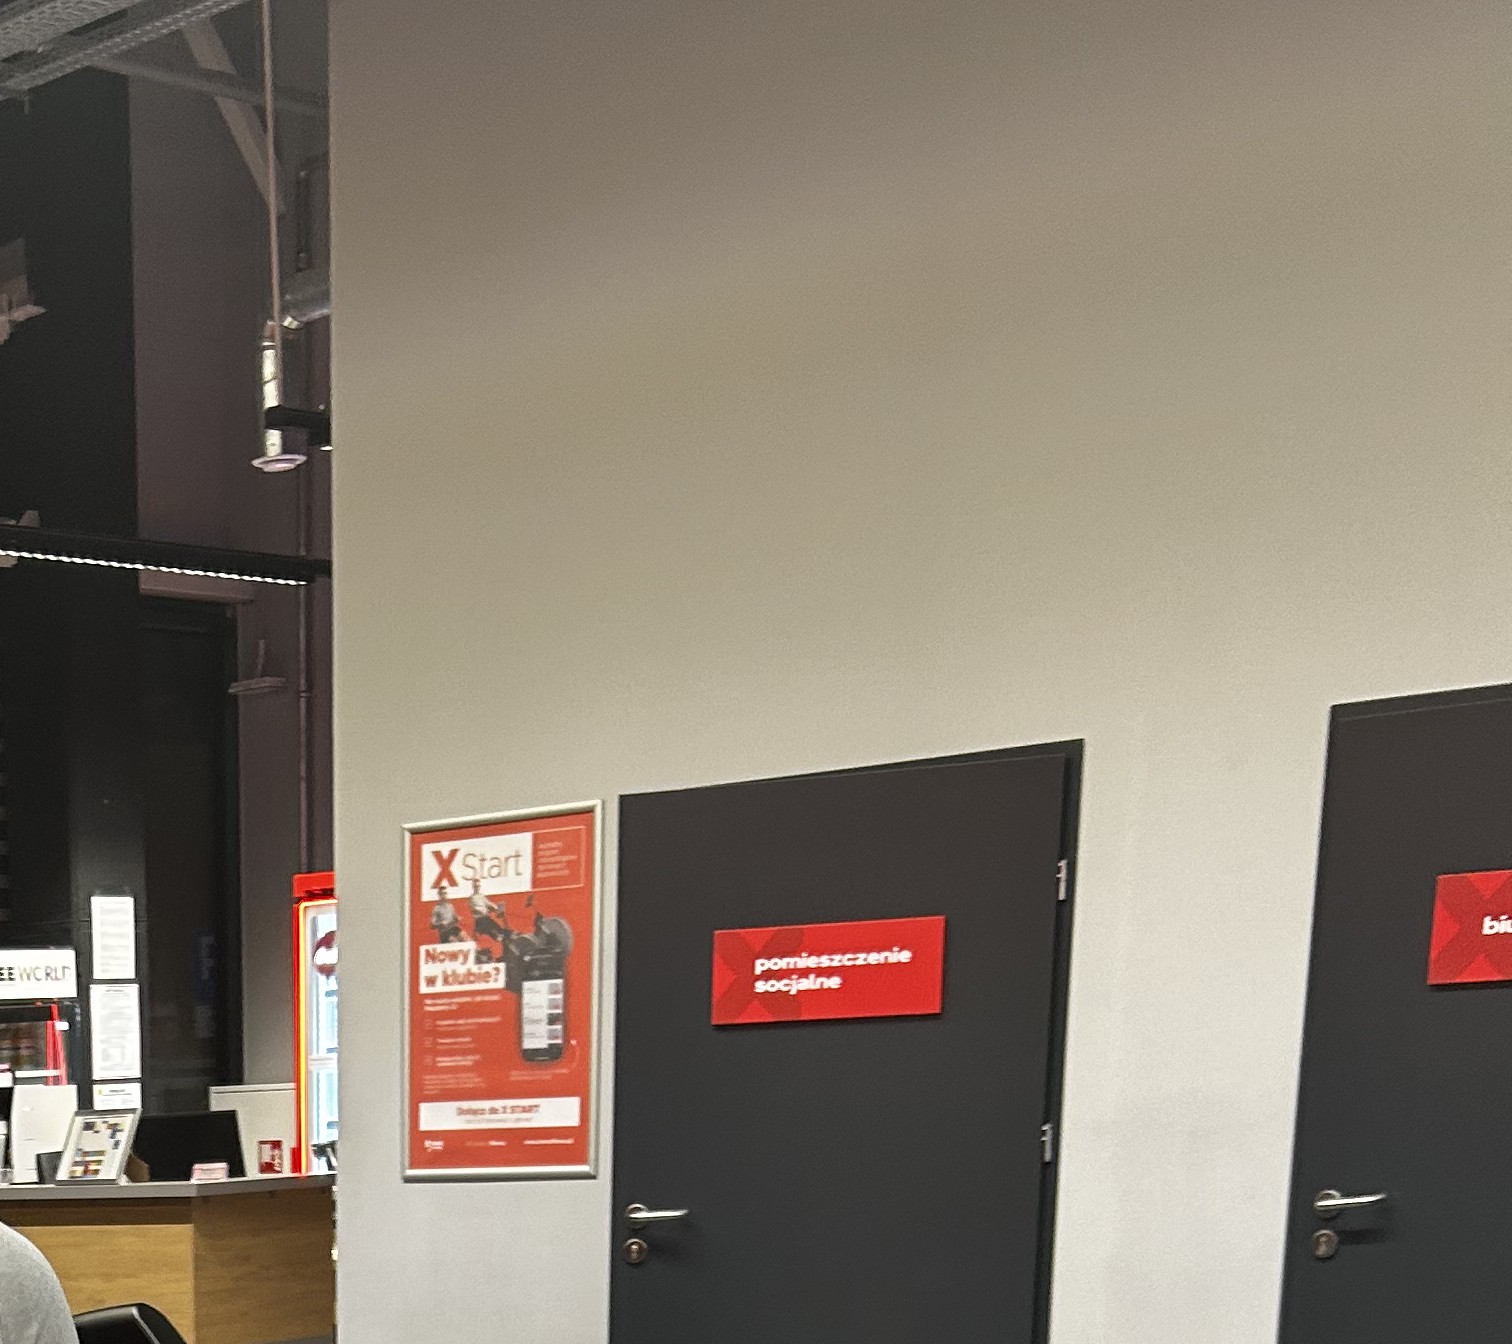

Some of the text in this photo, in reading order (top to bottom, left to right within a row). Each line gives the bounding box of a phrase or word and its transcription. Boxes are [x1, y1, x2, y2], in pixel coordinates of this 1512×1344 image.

[431, 848, 460, 889] X
[461, 849, 523, 881] Start
[1482, 915, 1512, 935] bi
[424, 948, 471, 965] Nowy
[754, 946, 913, 975] pomieszczenie
[424, 966, 501, 988] w klubie?
[754, 974, 842, 995] socjalne
